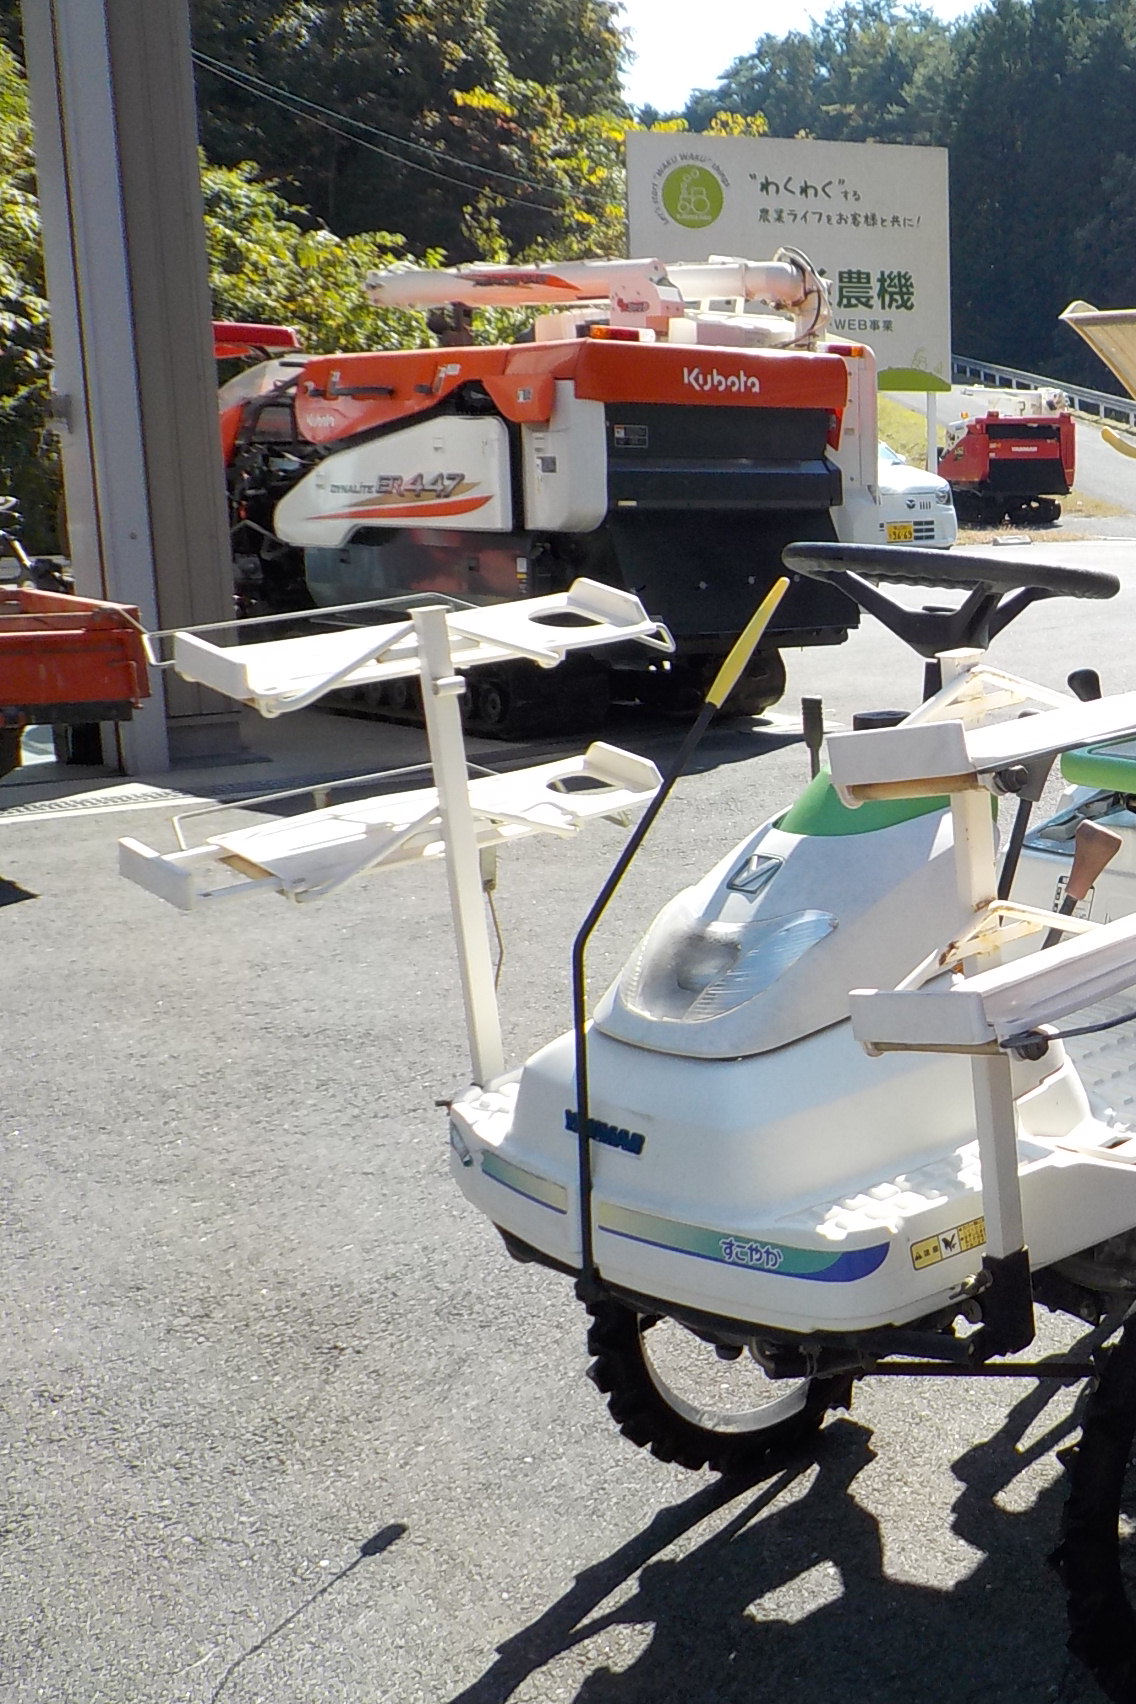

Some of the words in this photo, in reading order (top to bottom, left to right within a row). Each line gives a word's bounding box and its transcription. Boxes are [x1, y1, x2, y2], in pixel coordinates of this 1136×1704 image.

[818, 267, 915, 311] 農機
[682, 366, 760, 393] Kubota
[719, 1237, 784, 1269] すこやか
